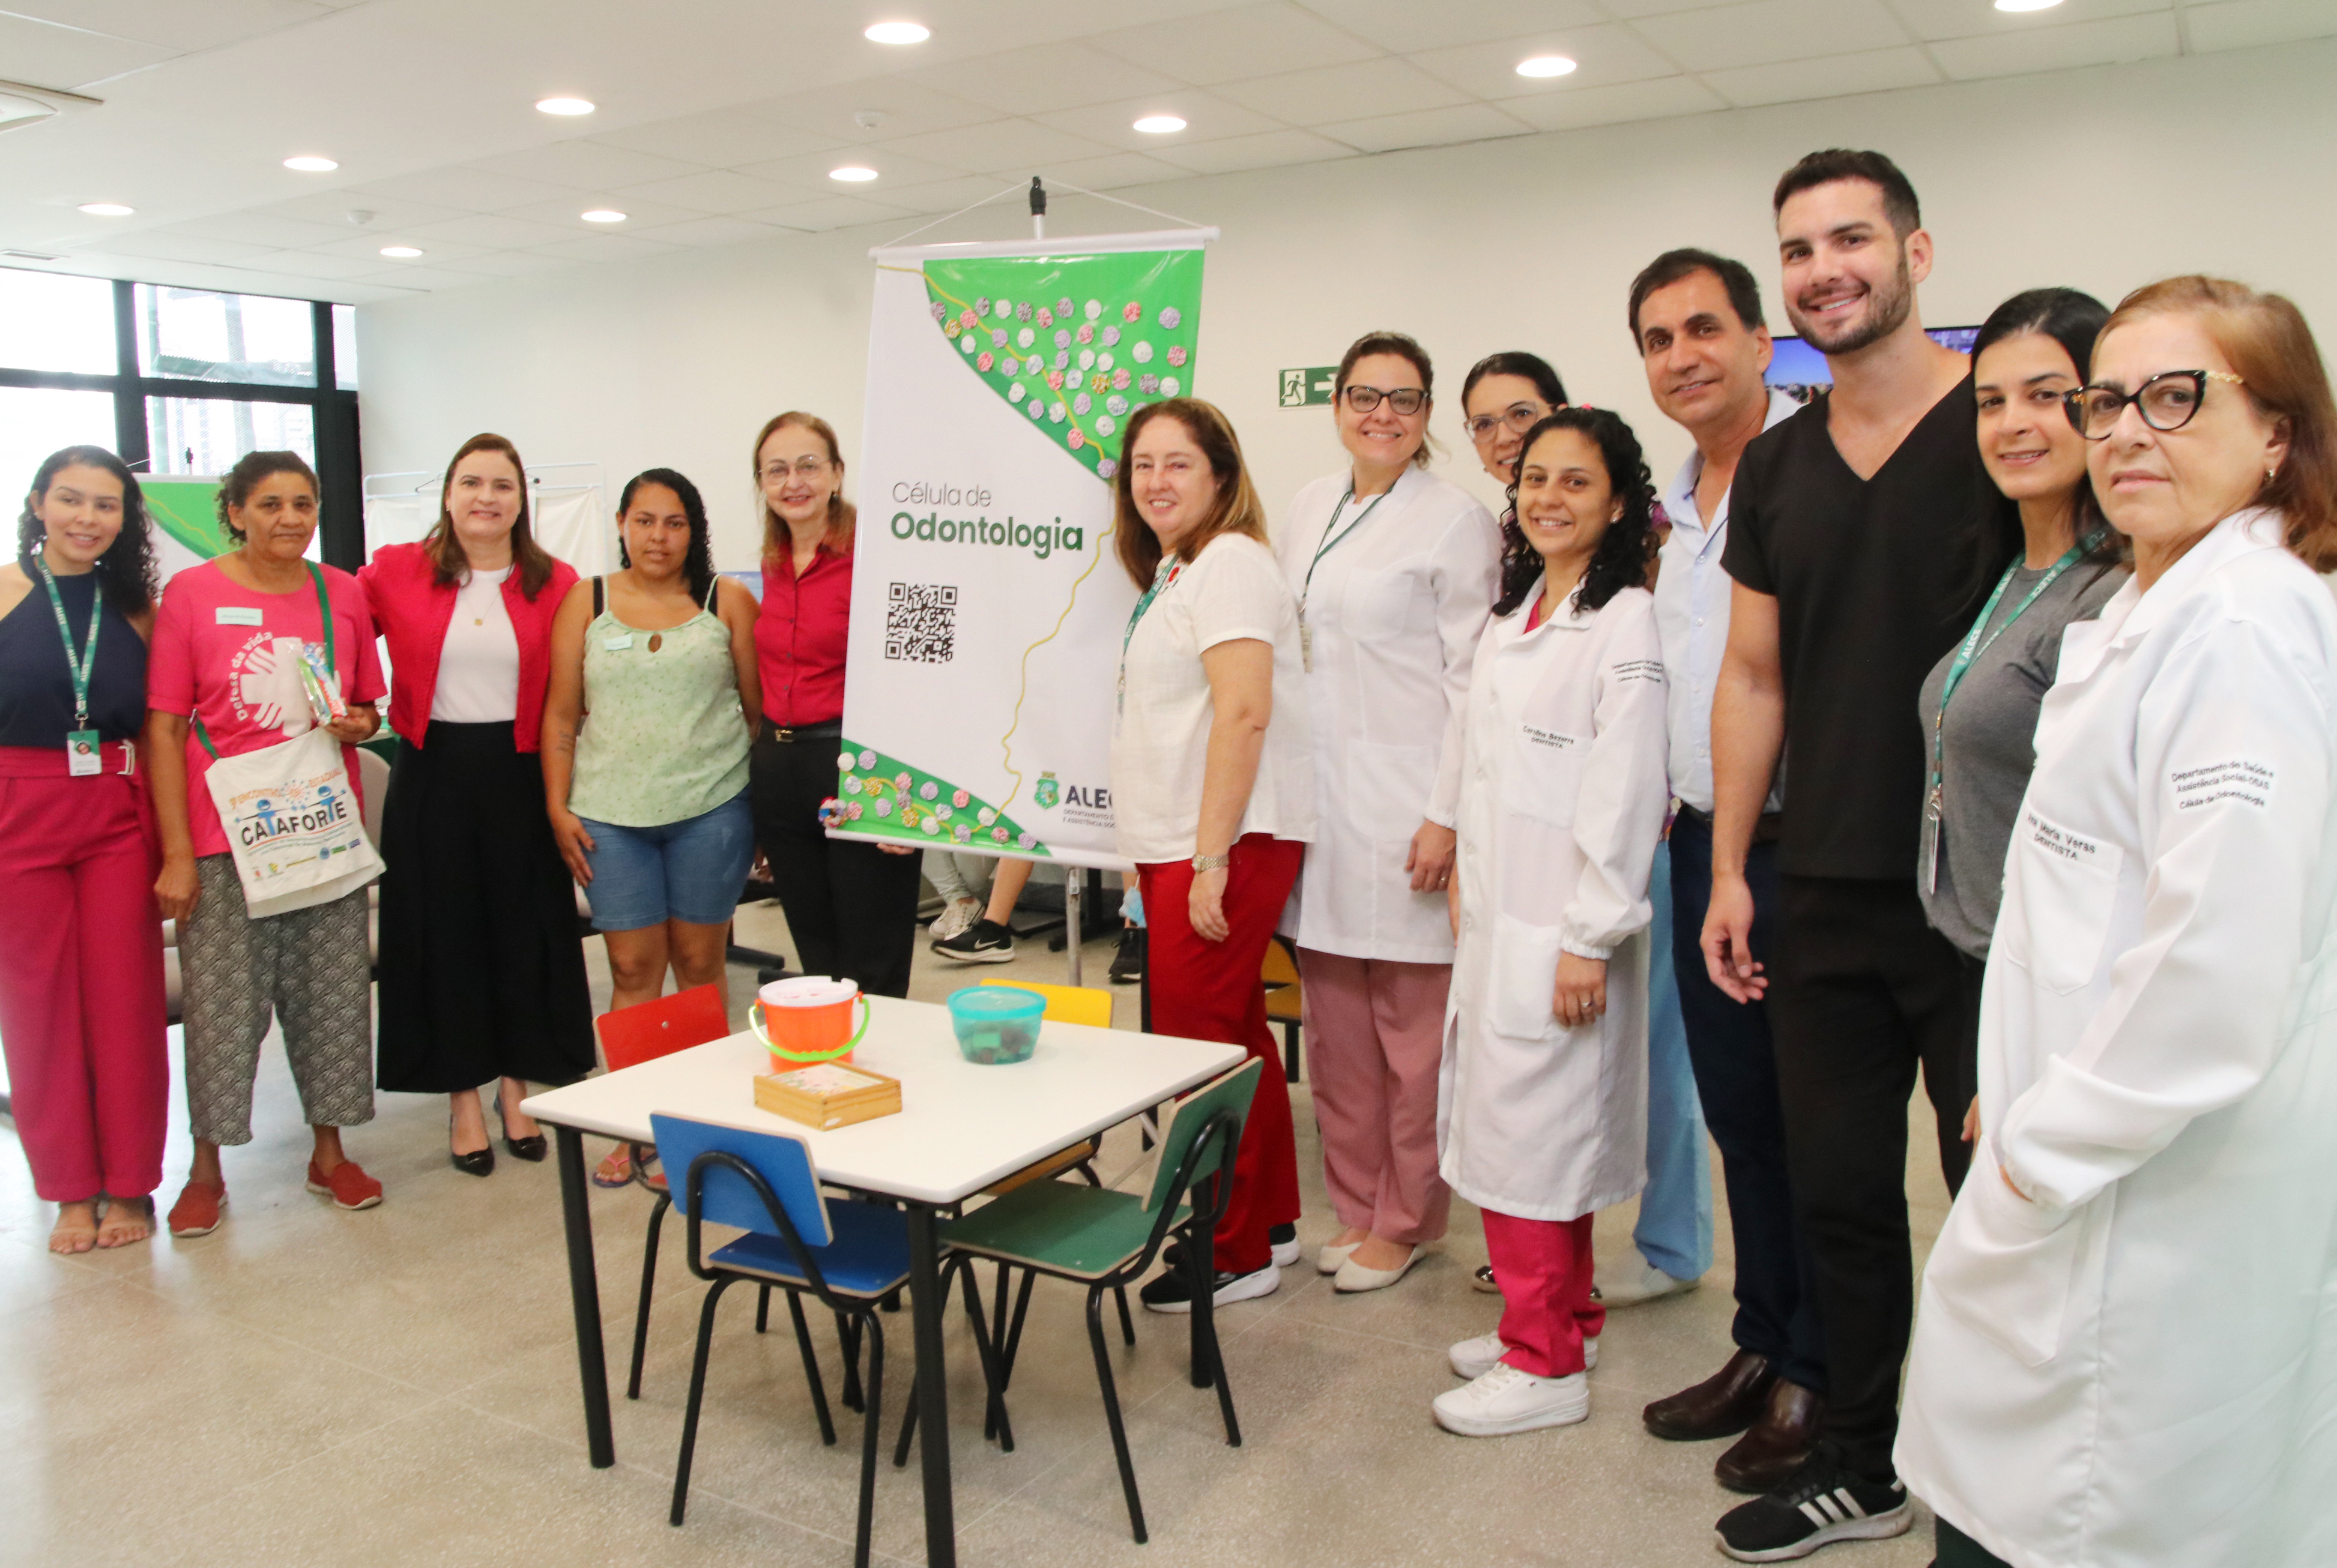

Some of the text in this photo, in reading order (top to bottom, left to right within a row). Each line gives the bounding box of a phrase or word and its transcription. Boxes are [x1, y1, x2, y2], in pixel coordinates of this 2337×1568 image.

[892, 481, 991, 507] Célula de
[890, 511, 1083, 559] Odontologia
[242, 632, 273, 651] vida
[1962, 629, 1982, 659] ALECE
[1531, 737, 1562, 749] DENTISTA
[1549, 734, 1574, 745] Bezerra
[2171, 764, 2227, 782] Departamento
[2228, 761, 2240, 769] de
[2243, 762, 2267, 776] Saúde
[2177, 777, 2219, 794] Assistência
[2179, 798, 2203, 809] Célula
[2215, 791, 2264, 807] Odontologia
[241, 795, 347, 846] CATAFORTE
[1063, 809, 1109, 821] DEPARTAMENTO
[1067, 817, 1102, 827] ASSISTÊNCIA
[2034, 833, 2077, 861] DENTISTA
[2066, 834, 2096, 854] Veras
